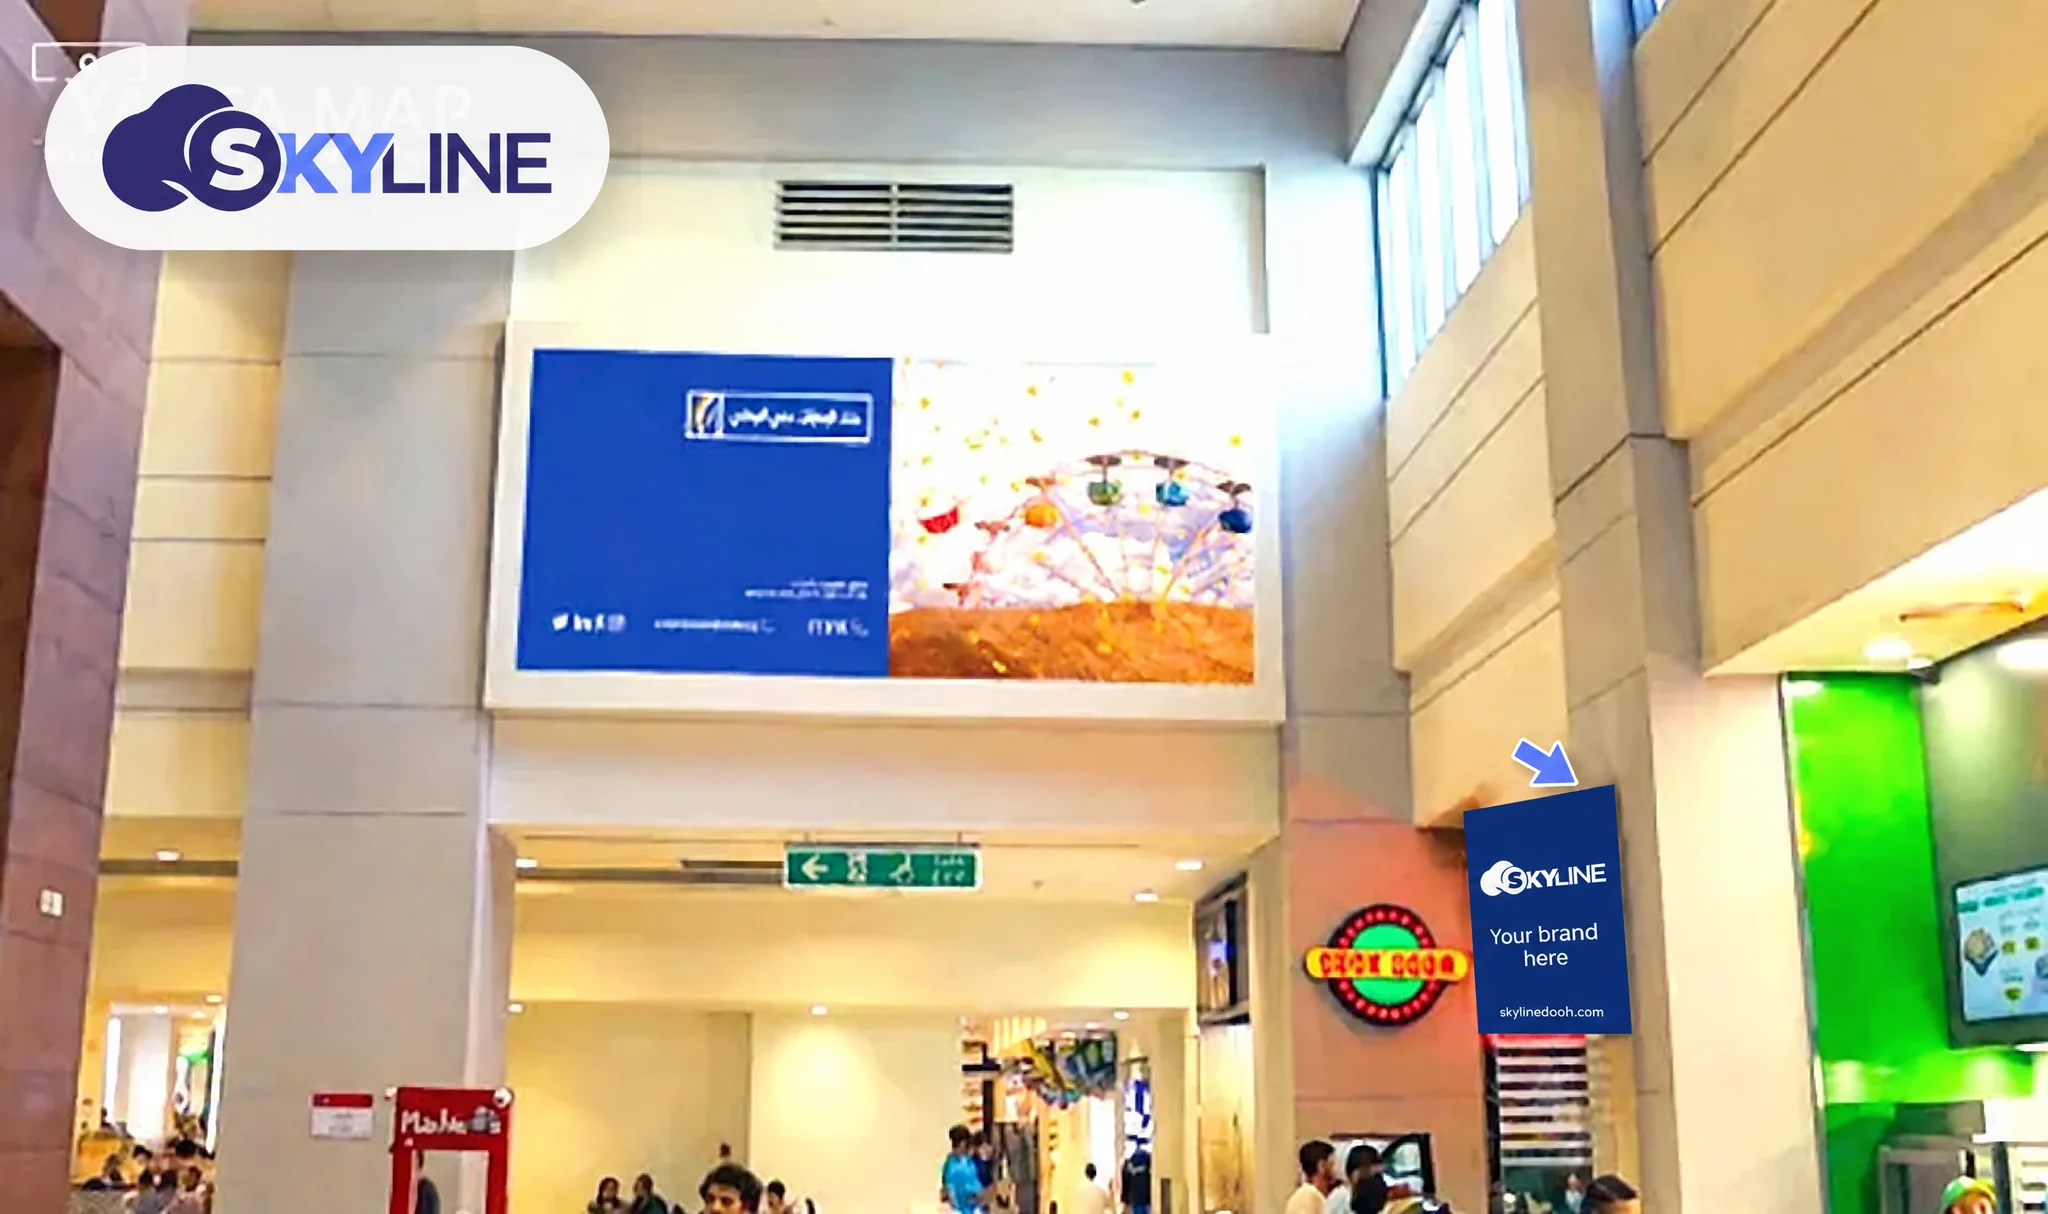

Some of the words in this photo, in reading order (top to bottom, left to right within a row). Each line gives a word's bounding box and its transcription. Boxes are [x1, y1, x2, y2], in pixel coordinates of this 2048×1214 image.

[1507, 863, 1607, 889] SKYLINE
[1490, 928, 1532, 945] Your
[1538, 922, 1598, 943] brand
[1524, 950, 1569, 967] here
[1500, 1006, 1604, 1020] skylinedooh.com
